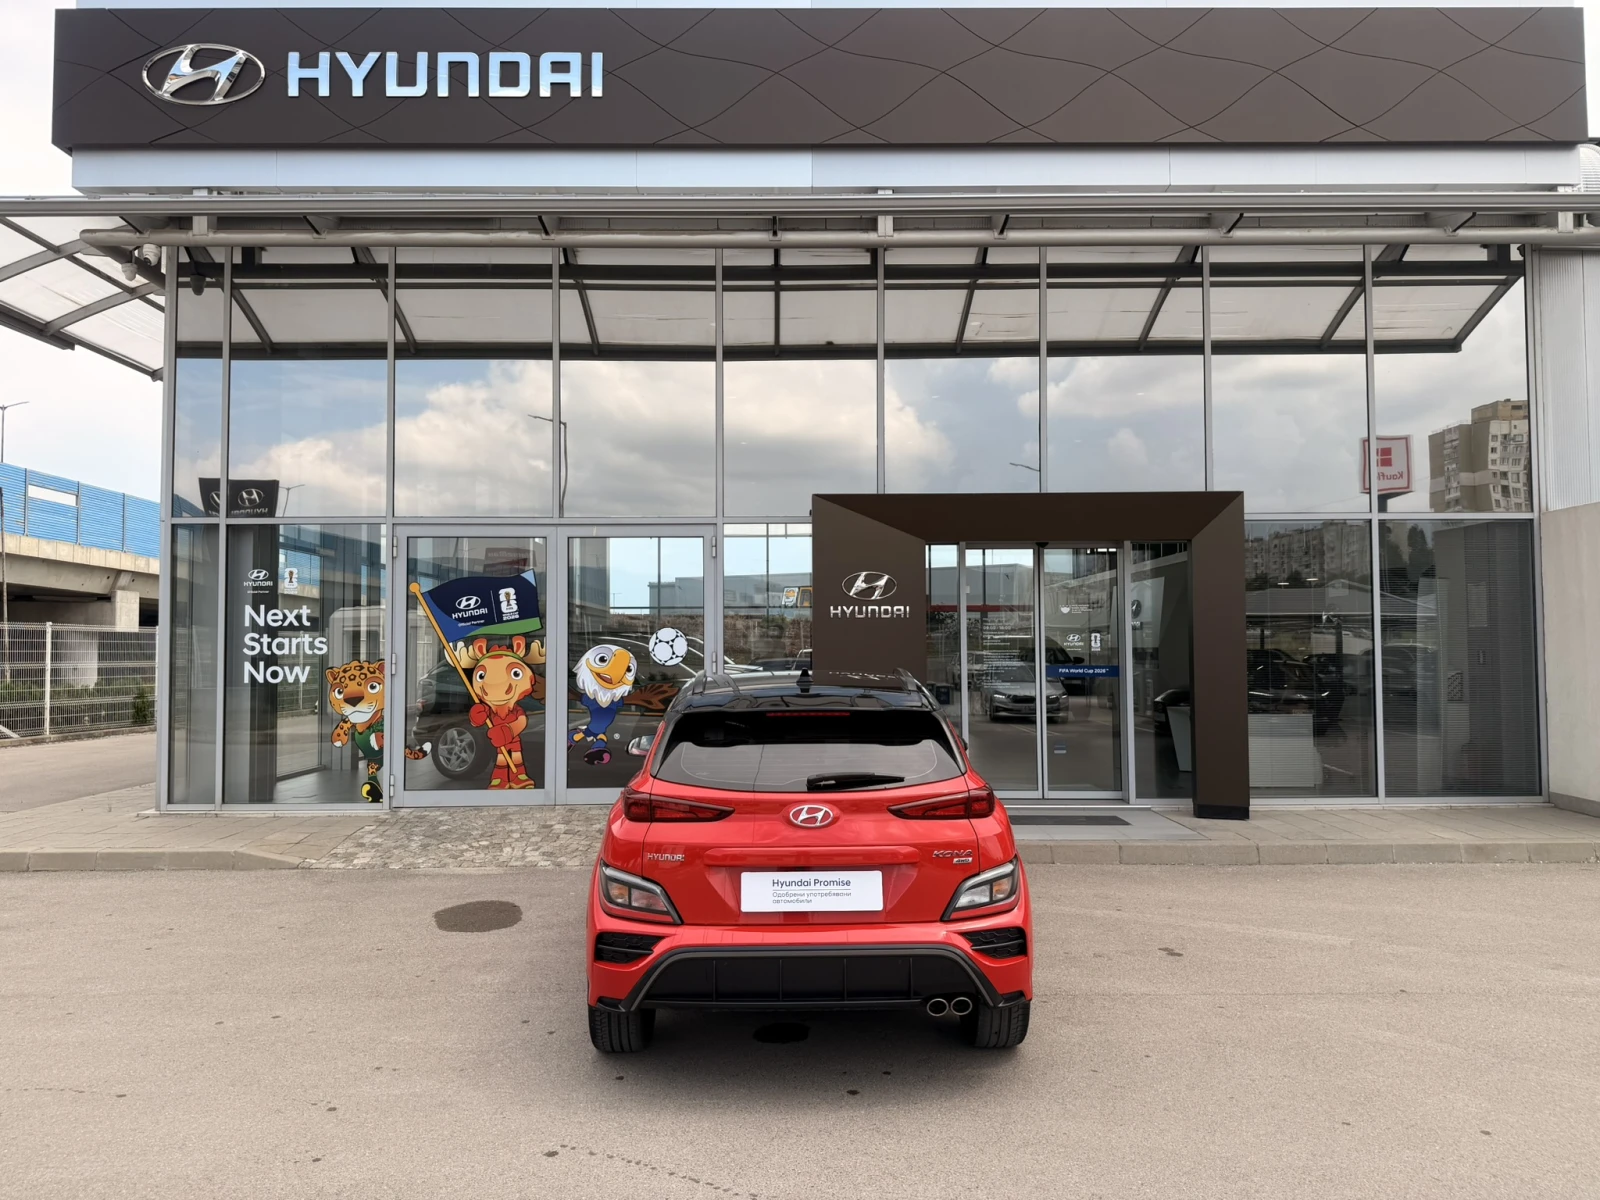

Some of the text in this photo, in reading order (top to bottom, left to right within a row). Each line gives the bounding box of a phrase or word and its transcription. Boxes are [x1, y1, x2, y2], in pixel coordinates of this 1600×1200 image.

[287, 51, 603, 97] HYUNDAI
[244, 604, 311, 627] Next
[451, 608, 488, 619] HYUNDAI
[830, 605, 910, 618] HYUNDAI
[242, 632, 328, 656] Starts
[243, 661, 311, 684] Now
[647, 852, 685, 862] HYUNDAI
[932, 849, 973, 858] KONA
[772, 877, 851, 889] Hyundai Promise
[806, 891, 852, 899] употребявани
